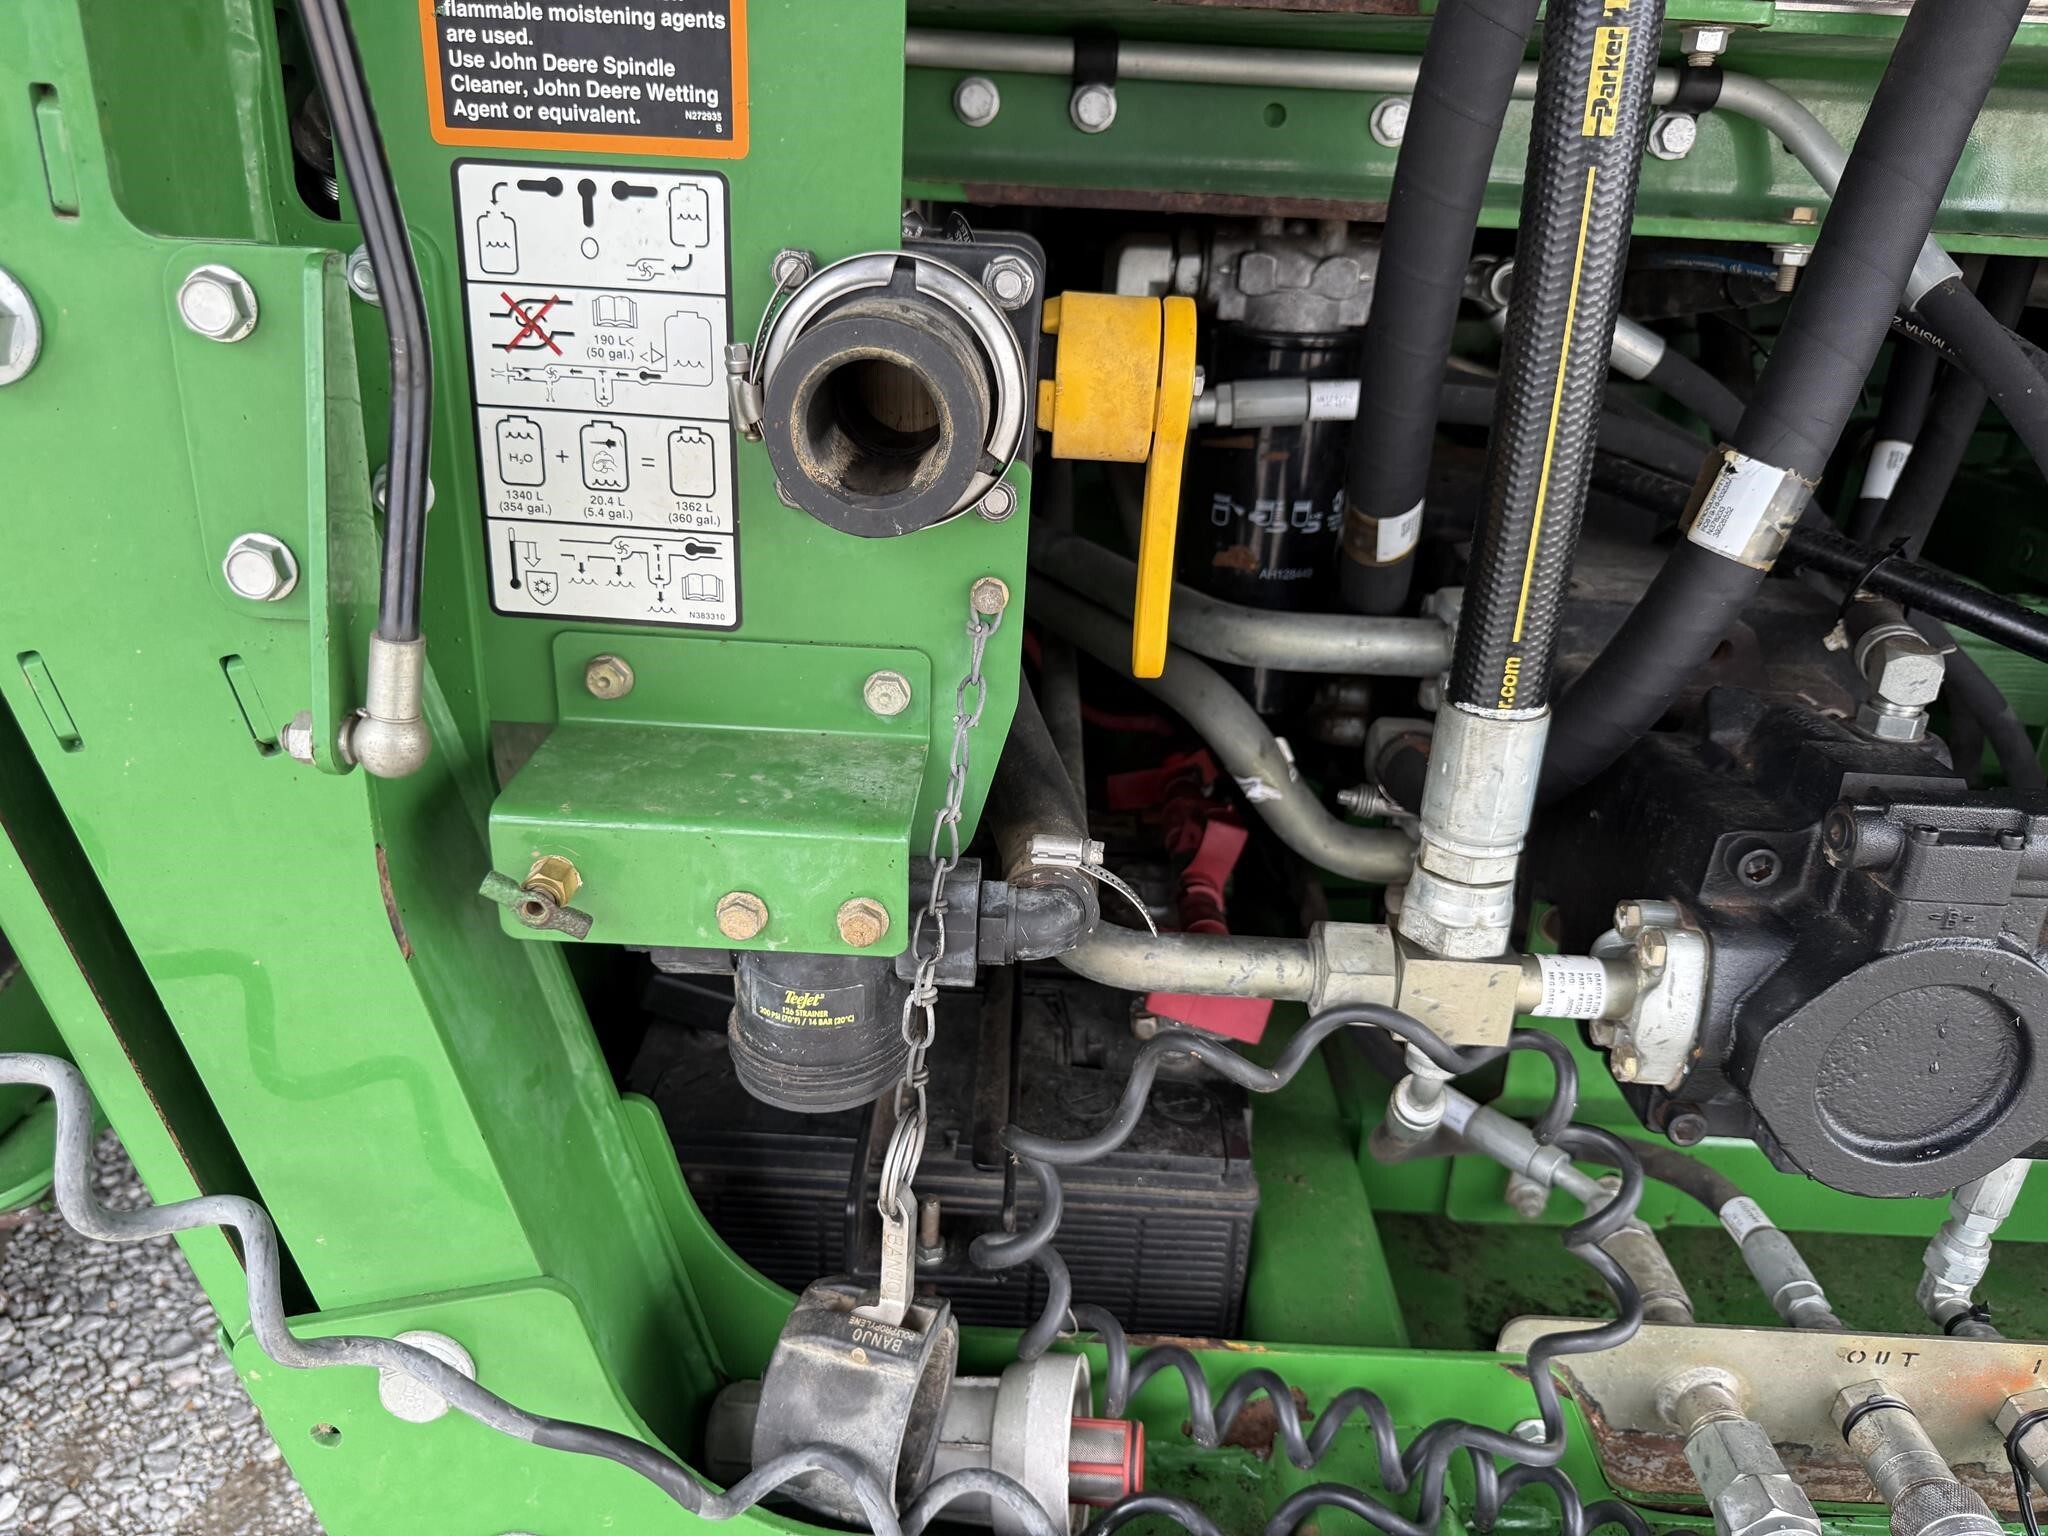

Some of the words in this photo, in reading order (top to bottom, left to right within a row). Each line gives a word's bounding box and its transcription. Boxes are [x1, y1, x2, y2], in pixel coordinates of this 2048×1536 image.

[444, 0, 543, 20] flammable
[549, 4, 656, 31] moistening
[660, 10, 726, 32] agents
[446, 27, 477, 43] are
[481, 27, 534, 46] used.
[448, 49, 486, 69] Use
[490, 51, 538, 72] John
[543, 53, 599, 74] Deere
[603, 55, 676, 78] Spindle
[1590, 29, 1624, 136] Parker
[450, 74, 529, 98] Cleaner,
[533, 78, 581, 98] John
[586, 80, 641, 101] Deere
[646, 83, 719, 108] Wetting
[453, 99, 509, 121] Agent
[513, 106, 534, 120] or
[538, 103, 641, 125] equivalent.
[684, 110, 722, 122] N272935
[593, 334, 615, 346] 190
[586, 346, 605, 360] (50
[608, 349, 635, 362] gal.)
[505, 490, 533, 500] 1340
[536, 491, 544, 501] L
[590, 495, 614, 506] 20.4
[618, 496, 625, 507] L
[499, 501, 523, 514] (354
[526, 503, 552, 516] gal.)
[583, 506, 604, 519] (5.4
[608, 508, 634, 521] gal.)
[675, 501, 702, 512] 1362
[706, 502, 713, 512] L
[668, 512, 693, 525] (360
[696, 514, 721, 527] gal.)
[689, 611, 726, 621] N383310
[784, 990, 824, 1010] TeeJet
[771, 1010, 781, 1020] PSI
[801, 1017, 807, 1026] /
[809, 1018, 818, 1026] 14
[818, 1018, 833, 1026] BAR
[782, 1006, 795, 1015] 126
[795, 1009, 829, 1018] STRAINER
[885, 1233, 905, 1294] BANJO
[848, 1315, 917, 1342] POLYPROPYLENE
[851, 1327, 904, 1353] BANJO
[1847, 1350, 1920, 1368] OUT
